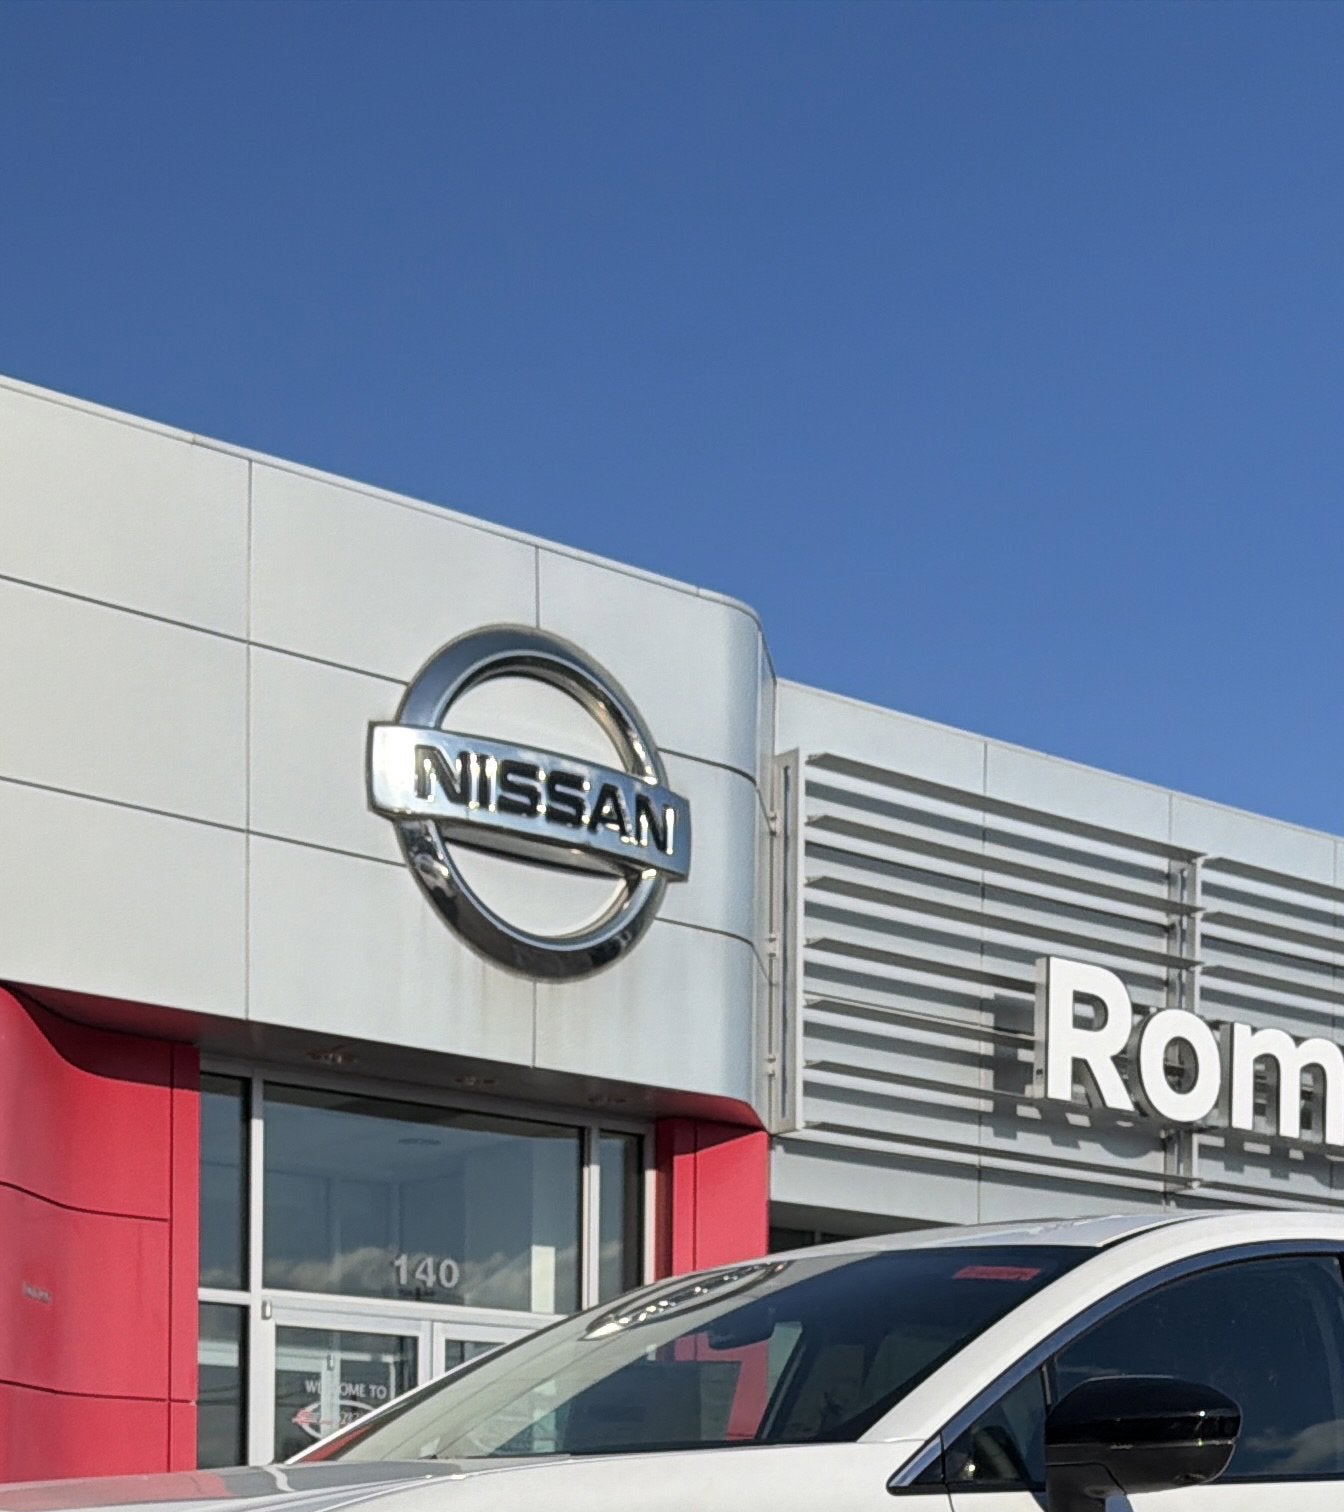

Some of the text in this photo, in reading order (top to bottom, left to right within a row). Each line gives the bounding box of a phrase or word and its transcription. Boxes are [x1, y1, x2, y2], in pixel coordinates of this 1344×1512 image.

[414, 744, 675, 856] NISSAN
[394, 1254, 460, 1289] 140
[304, 1379, 387, 1400] WOME TO
